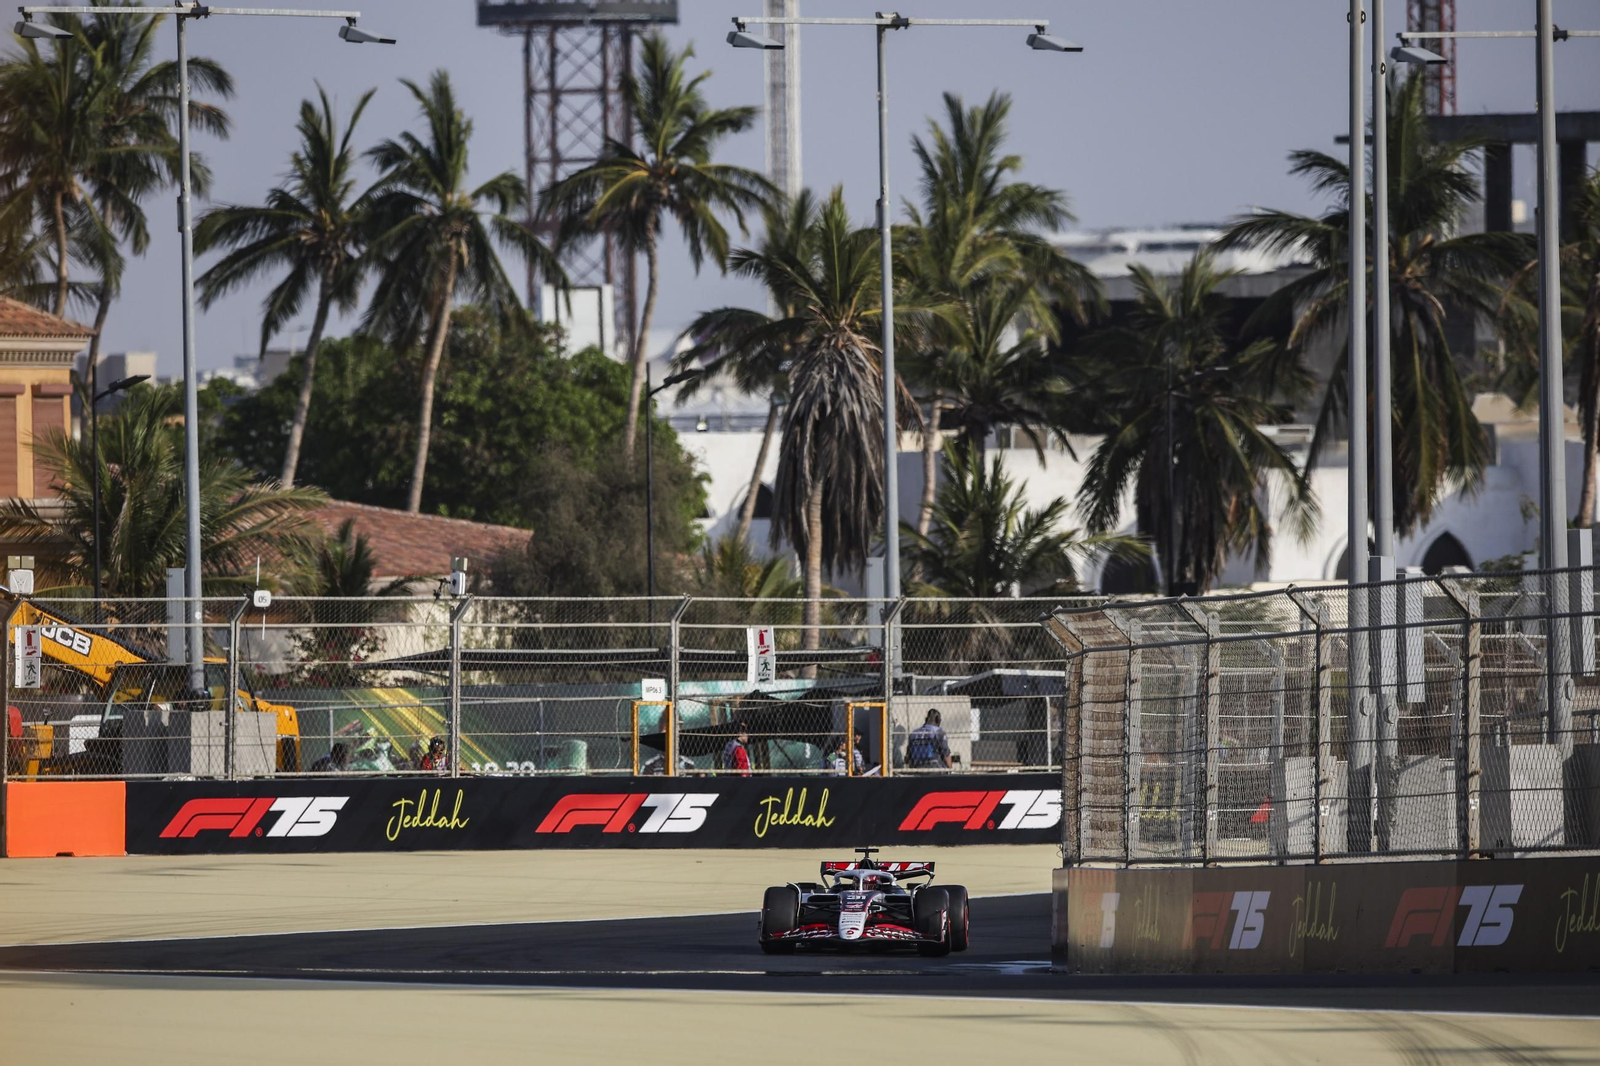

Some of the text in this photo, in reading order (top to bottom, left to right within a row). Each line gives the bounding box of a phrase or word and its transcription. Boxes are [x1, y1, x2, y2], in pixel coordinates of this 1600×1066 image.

[41, 620, 92, 656] JCB
[386, 789, 470, 842] Jeddah
[754, 787, 835, 838] Jeddah
[1288, 881, 1339, 957] Jeddah
